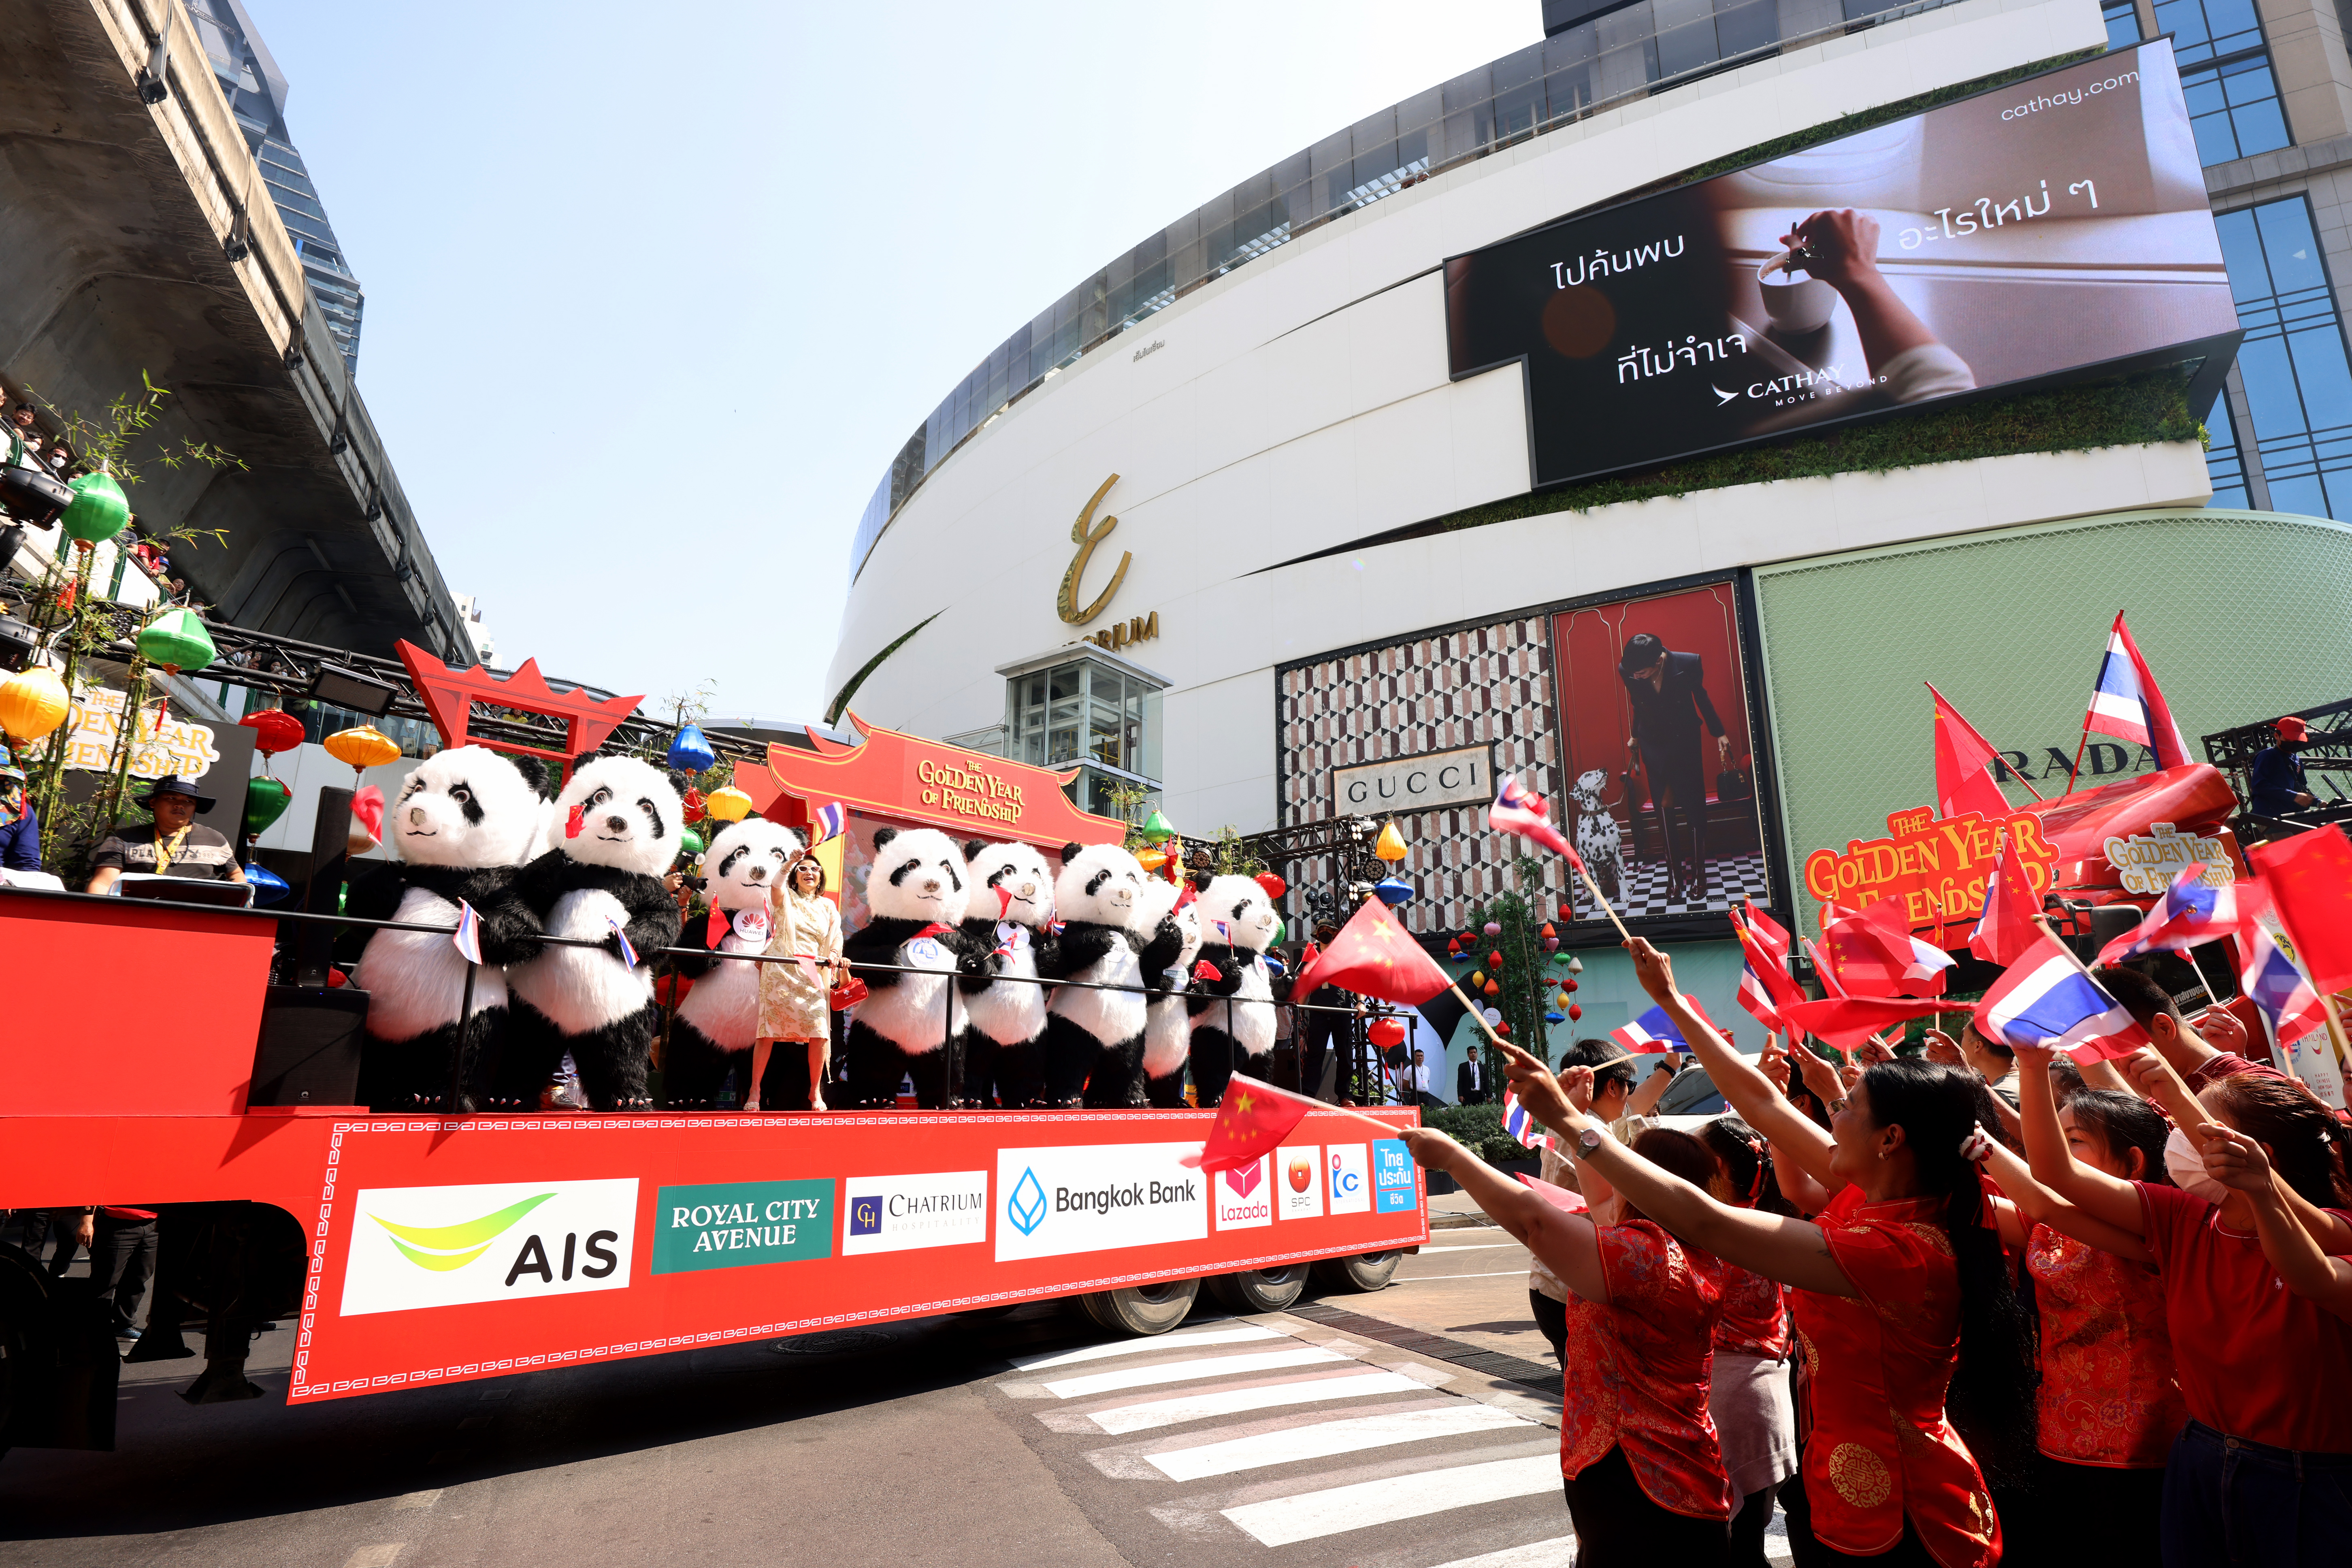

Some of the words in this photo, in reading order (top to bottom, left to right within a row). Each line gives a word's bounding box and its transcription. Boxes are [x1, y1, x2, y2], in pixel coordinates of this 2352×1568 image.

[2002, 72, 2139, 120] cathay.com
[1898, 179, 2050, 250] อะไรใหม่
[1550, 235, 1684, 289] ไปค้นพบ
[1618, 334, 1747, 383] ที่ไม่จำเจ
[1747, 364, 1845, 398] CATHAY
[1775, 392, 1815, 407] MOVE
[1826, 376, 1887, 395] BEYOND
[91, 691, 123, 709] THE
[967, 760, 982, 773] THE
[1993, 743, 2154, 782] RADA
[919, 760, 985, 793] GOLDEN
[985, 774, 1025, 806] YEAR
[1348, 763, 1476, 803] GUCCI
[922, 790, 938, 803] OF
[942, 788, 1021, 824] FRIENDSHIP
[1893, 813, 1931, 837] THE
[2156, 827, 2175, 839] THE
[1809, 837, 1940, 901] GOLDEN
[1940, 819, 2051, 871] YEAR
[2109, 839, 2184, 870] GOLDEN
[2180, 837, 2231, 864] YEAR
[2125, 874, 2144, 891] OF
[1380, 1148, 1403, 1167] ไทย
[1379, 1167, 1411, 1186] ประกัน
[889, 1194, 981, 1216] CHATRIUM
[1056, 1182, 1144, 1214] Bangkok
[1150, 1179, 1196, 1204] Bank
[1222, 1201, 1268, 1221] Lazada
[1291, 1197, 1310, 1207] SPC
[1390, 1193, 1404, 1205] ชีวิต
[671, 1202, 758, 1229] ROYAL
[765, 1199, 819, 1221] CITY
[893, 1217, 979, 1231] HOSPITALITY
[692, 1225, 796, 1253] AVENUE
[505, 1230, 618, 1287] AIS
